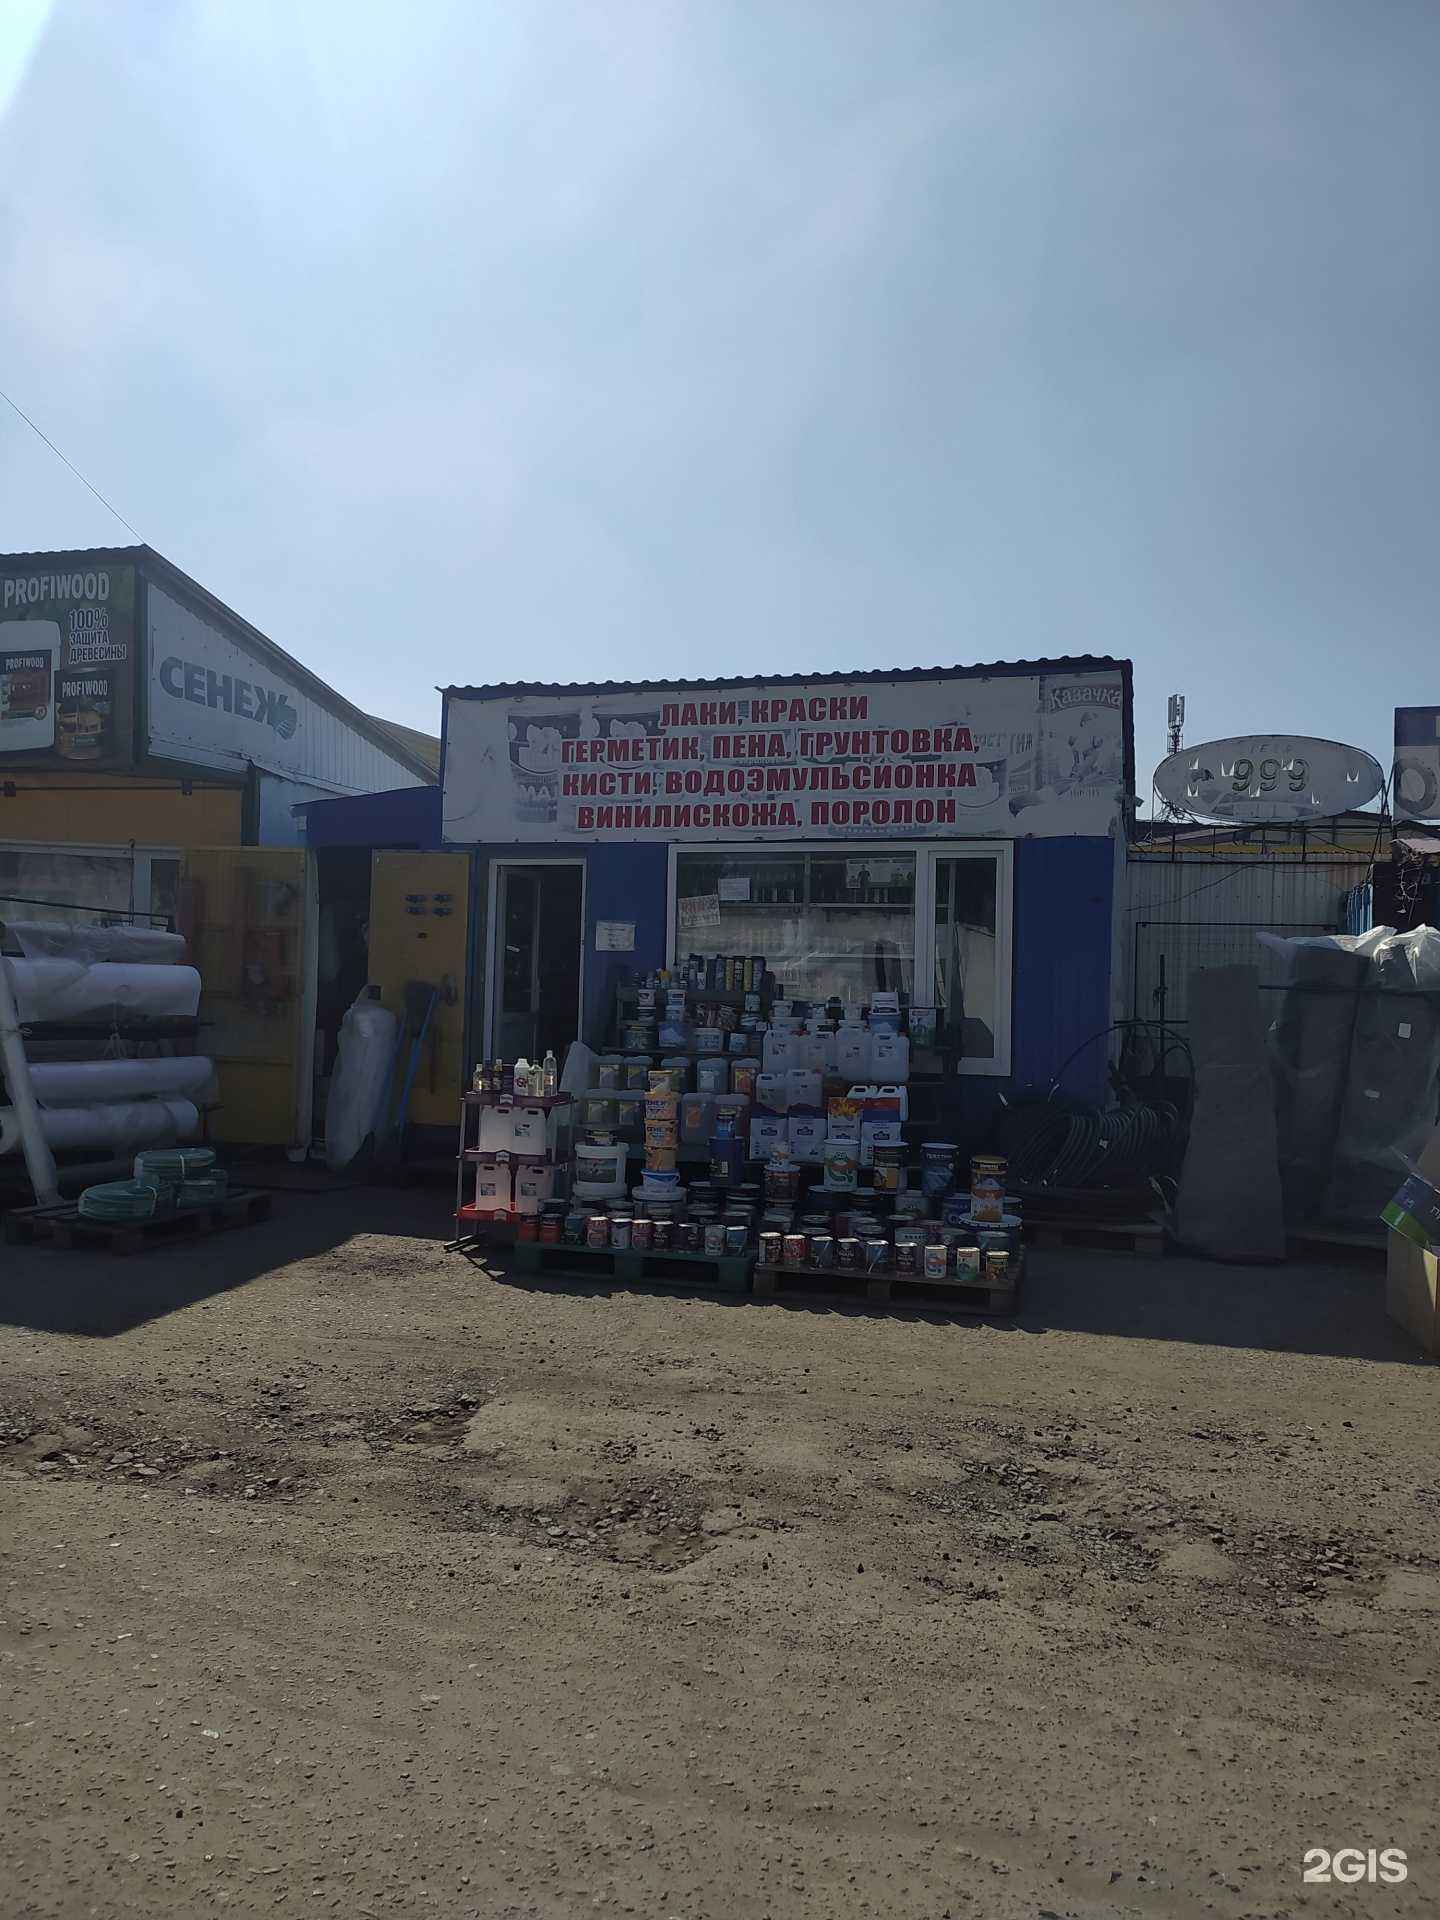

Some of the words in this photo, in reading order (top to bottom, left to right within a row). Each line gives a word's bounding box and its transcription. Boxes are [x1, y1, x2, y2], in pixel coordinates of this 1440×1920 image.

[4, 572, 110, 607] PROFIWOOD
[70, 608, 109, 630] 100%
[70, 630, 110, 646] ЗАЩИТА
[6, 656, 44, 672] PROFIWOOD
[69, 643, 127, 664] ДРЕВЕСИНЫ
[62, 680, 108, 698] PROFIWOOD
[160, 656, 289, 727] СЕНЕЖ
[660, 702, 743, 726] ЛАКИ,
[751, 696, 868, 723] КРАСКИ
[561, 736, 705, 763] ГЕРМЕТИК,
[712, 733, 792, 759] ПЕНА,
[800, 727, 980, 756] ГРУНТОВКА,
[563, 772, 658, 796] КИСТИ,
[665, 763, 977, 796] ВОДОЭМУЛЬСИОНКА
[1231, 758, 1307, 792] 999
[577, 802, 803, 829] ВИНИЛИСКОЖА,
[810, 799, 956, 825] ПОРОЛОН
